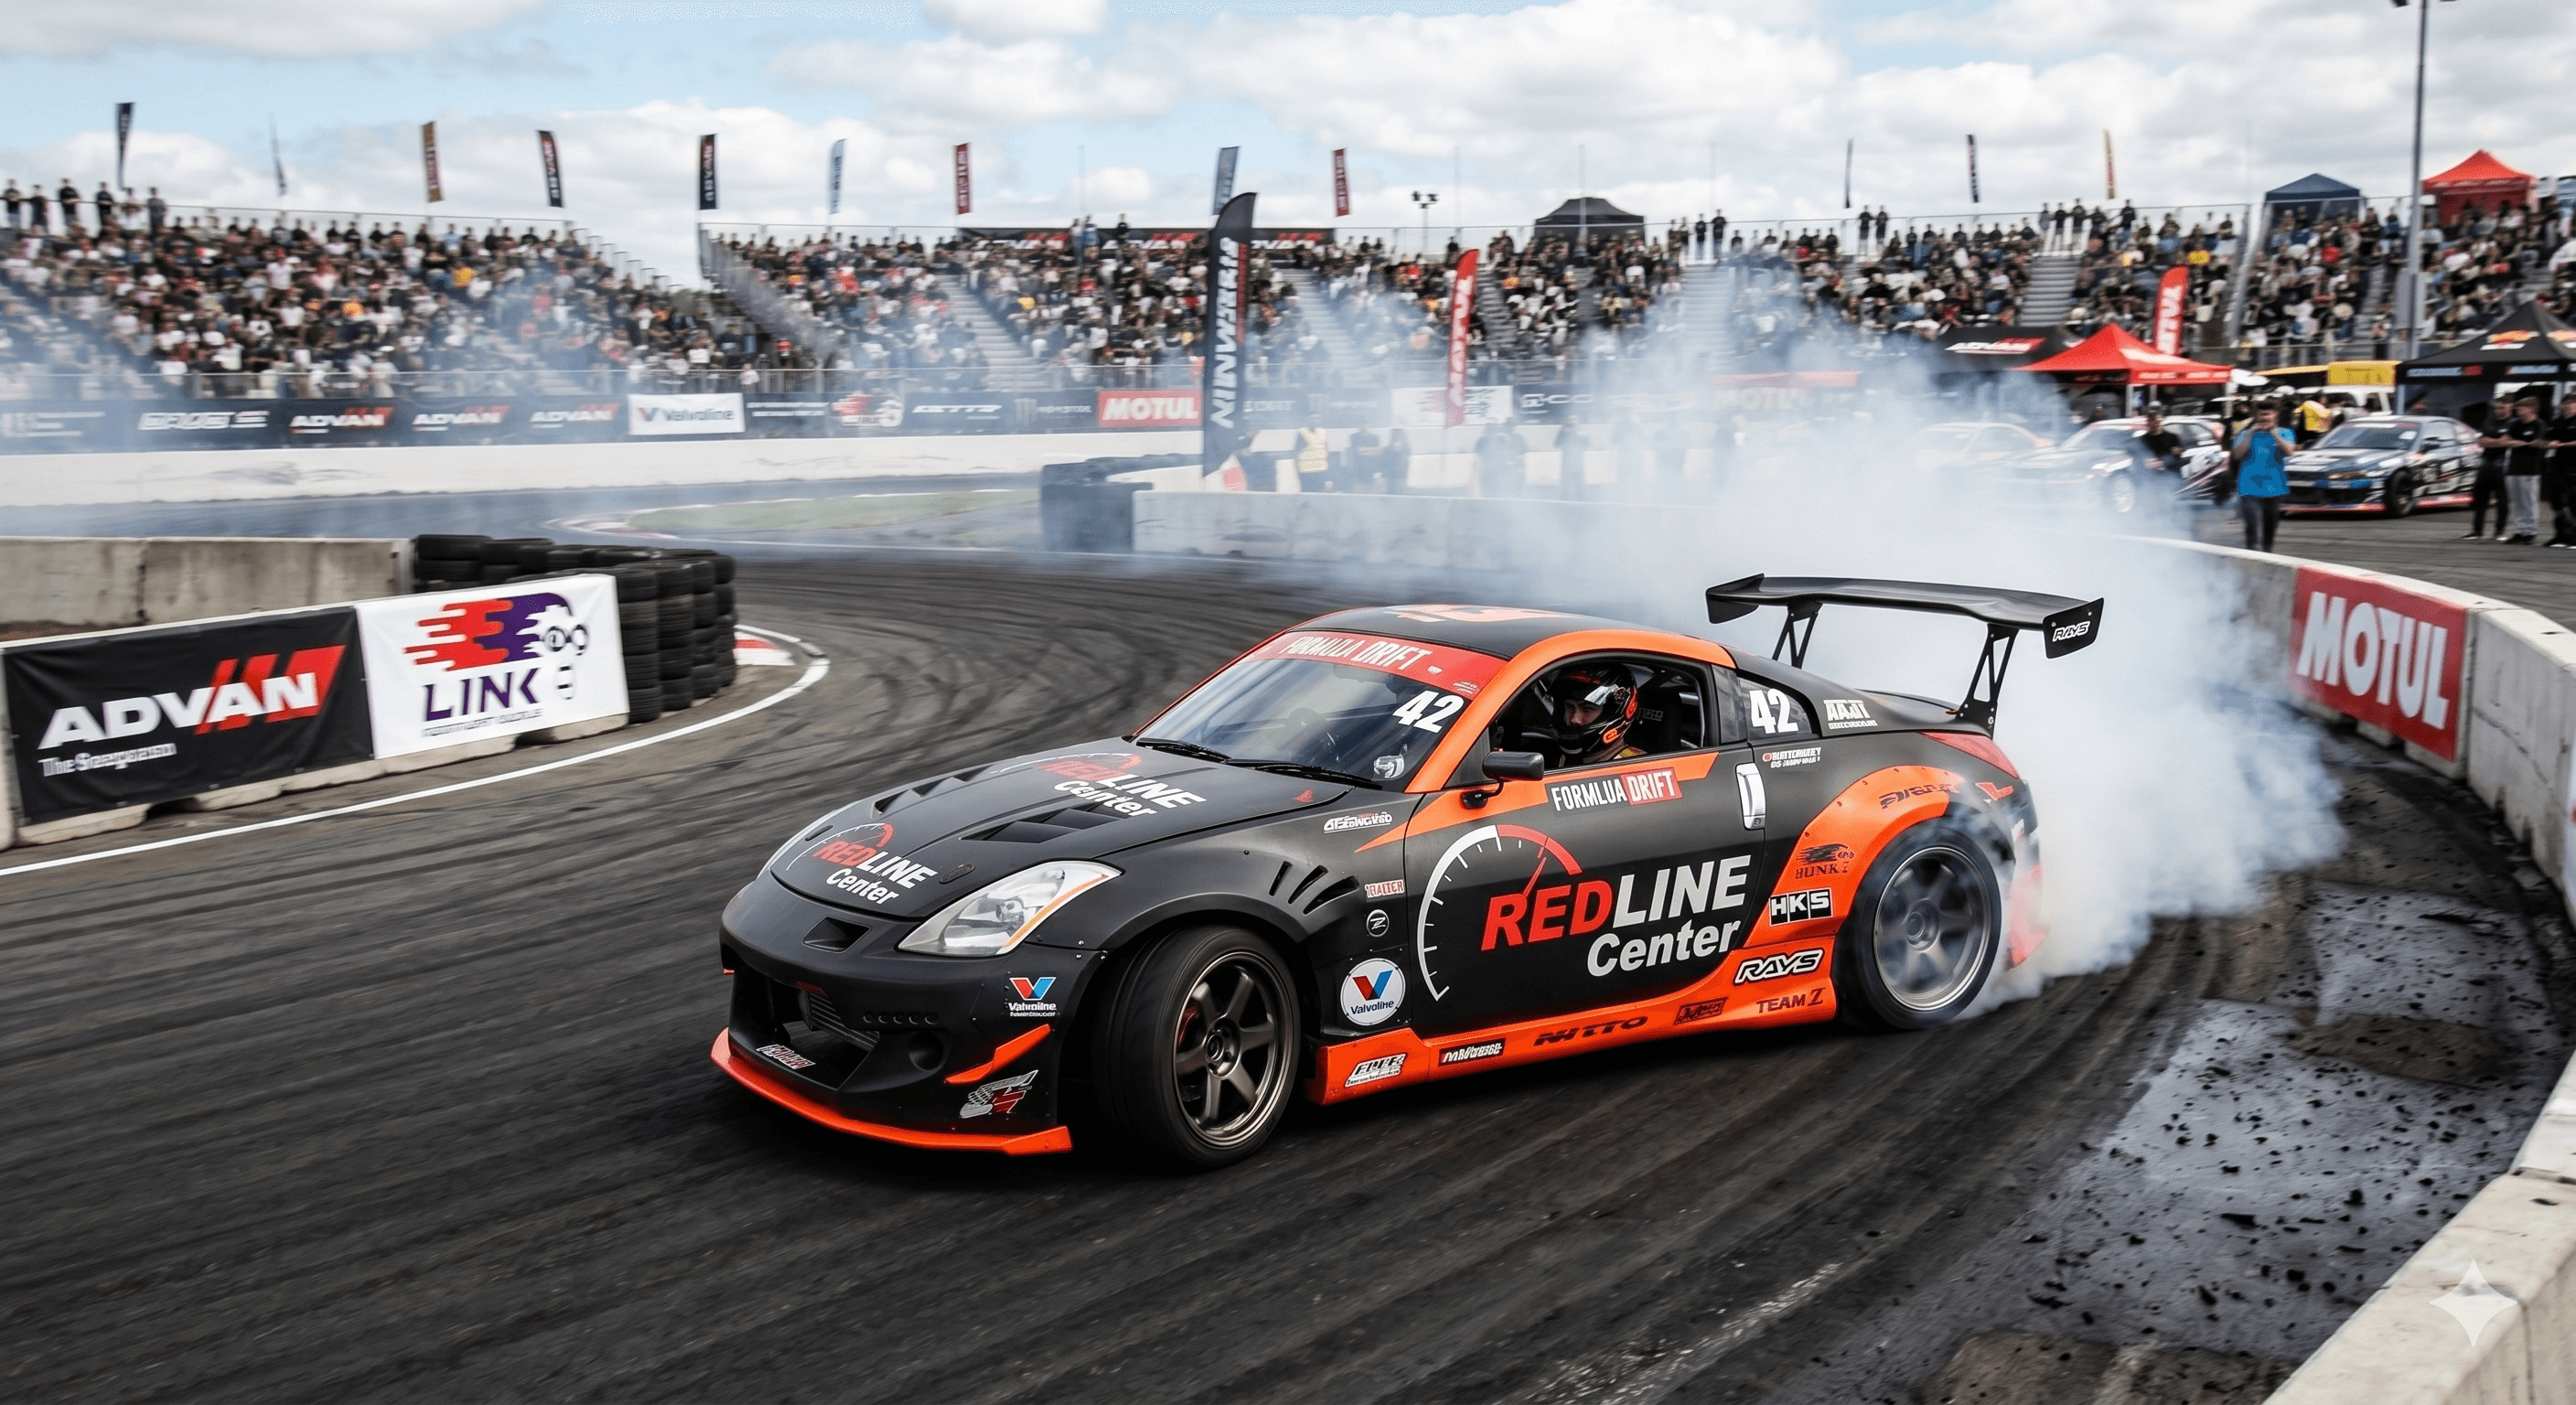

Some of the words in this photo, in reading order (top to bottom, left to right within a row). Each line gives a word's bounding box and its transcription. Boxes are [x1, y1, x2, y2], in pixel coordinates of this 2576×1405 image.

[289, 414, 385, 426] ADVAN
[412, 413, 501, 424] ADVAN
[1102, 397, 1199, 420] MOTUL
[1350, 641, 1433, 670] DRIFT
[2296, 591, 2450, 730] MOTUL
[37, 671, 319, 749] ADVAN
[422, 668, 541, 722] LINK
[1392, 690, 1465, 734] 42
[1749, 688, 1799, 735] 42
[1551, 778, 1627, 811] FORMLUA
[1626, 770, 1676, 802] DRIFT
[812, 840, 939, 889] REDLINE
[826, 868, 900, 905] Center
[1480, 854, 1752, 951] REDLINE
[1771, 891, 1830, 917] HKS
[1587, 920, 1742, 977] Center
[1734, 949, 1824, 984] RAYS
[1756, 993, 1807, 1014] TEAM
[1807, 987, 1827, 1007] Z
